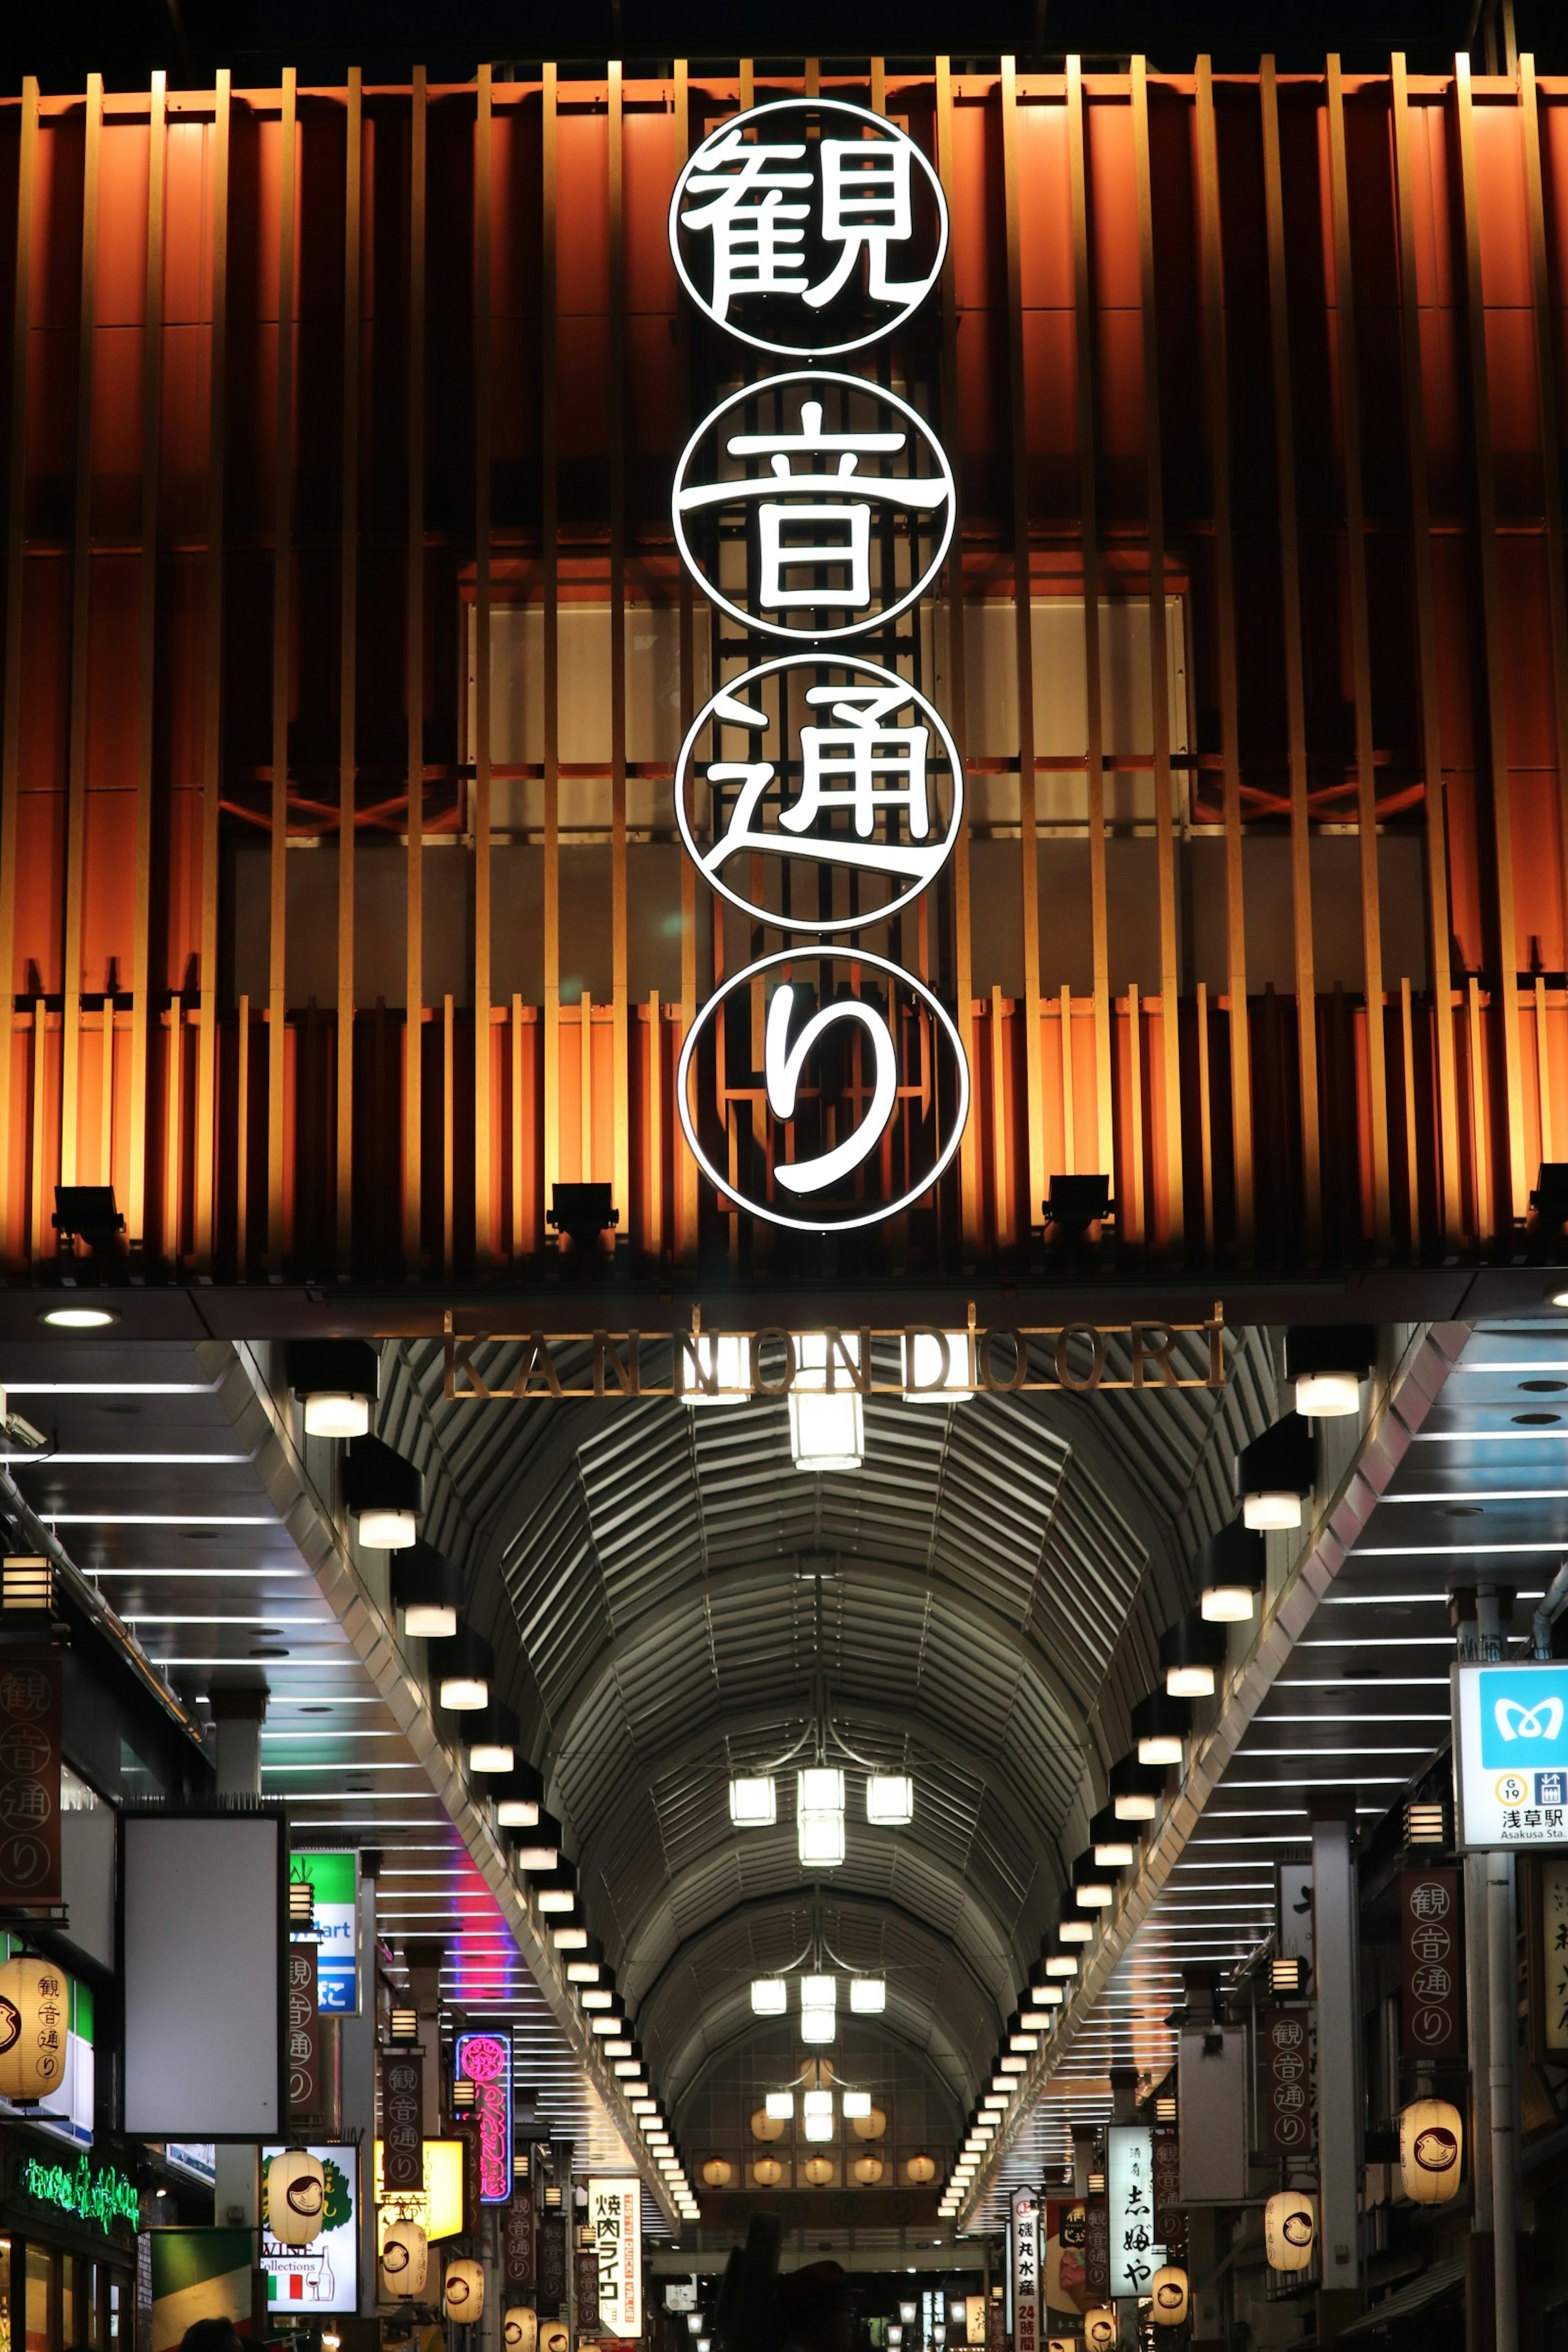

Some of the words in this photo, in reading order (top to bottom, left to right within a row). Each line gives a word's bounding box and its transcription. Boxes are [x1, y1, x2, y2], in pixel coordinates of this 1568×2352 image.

[670, 102, 969, 1227] 観音通り
[0, 1670, 51, 1886] 観音通り
[1503, 1809, 1563, 1828] 浅草駅
[1505, 1789, 1519, 1799] 19
[1507, 1779, 1515, 1788] G
[1501, 1830, 1543, 1839] Asakusa
[1547, 1829, 1566, 1838] Sta.
[1411, 1883, 1451, 2045] 観音通り
[38, 1977, 60, 2078] 観音通り
[1273, 2020, 1305, 2144] 観音通り
[390, 2067, 418, 2181] 観音通り
[509, 2196, 530, 2279] 観音通り
[596, 2194, 620, 2300] 焼肉ライク
[1018, 2223, 1034, 2296] 磯丸水産
[1089, 2210, 1108, 2284] 観音通り
[581, 2259, 597, 2323] 観音通り
